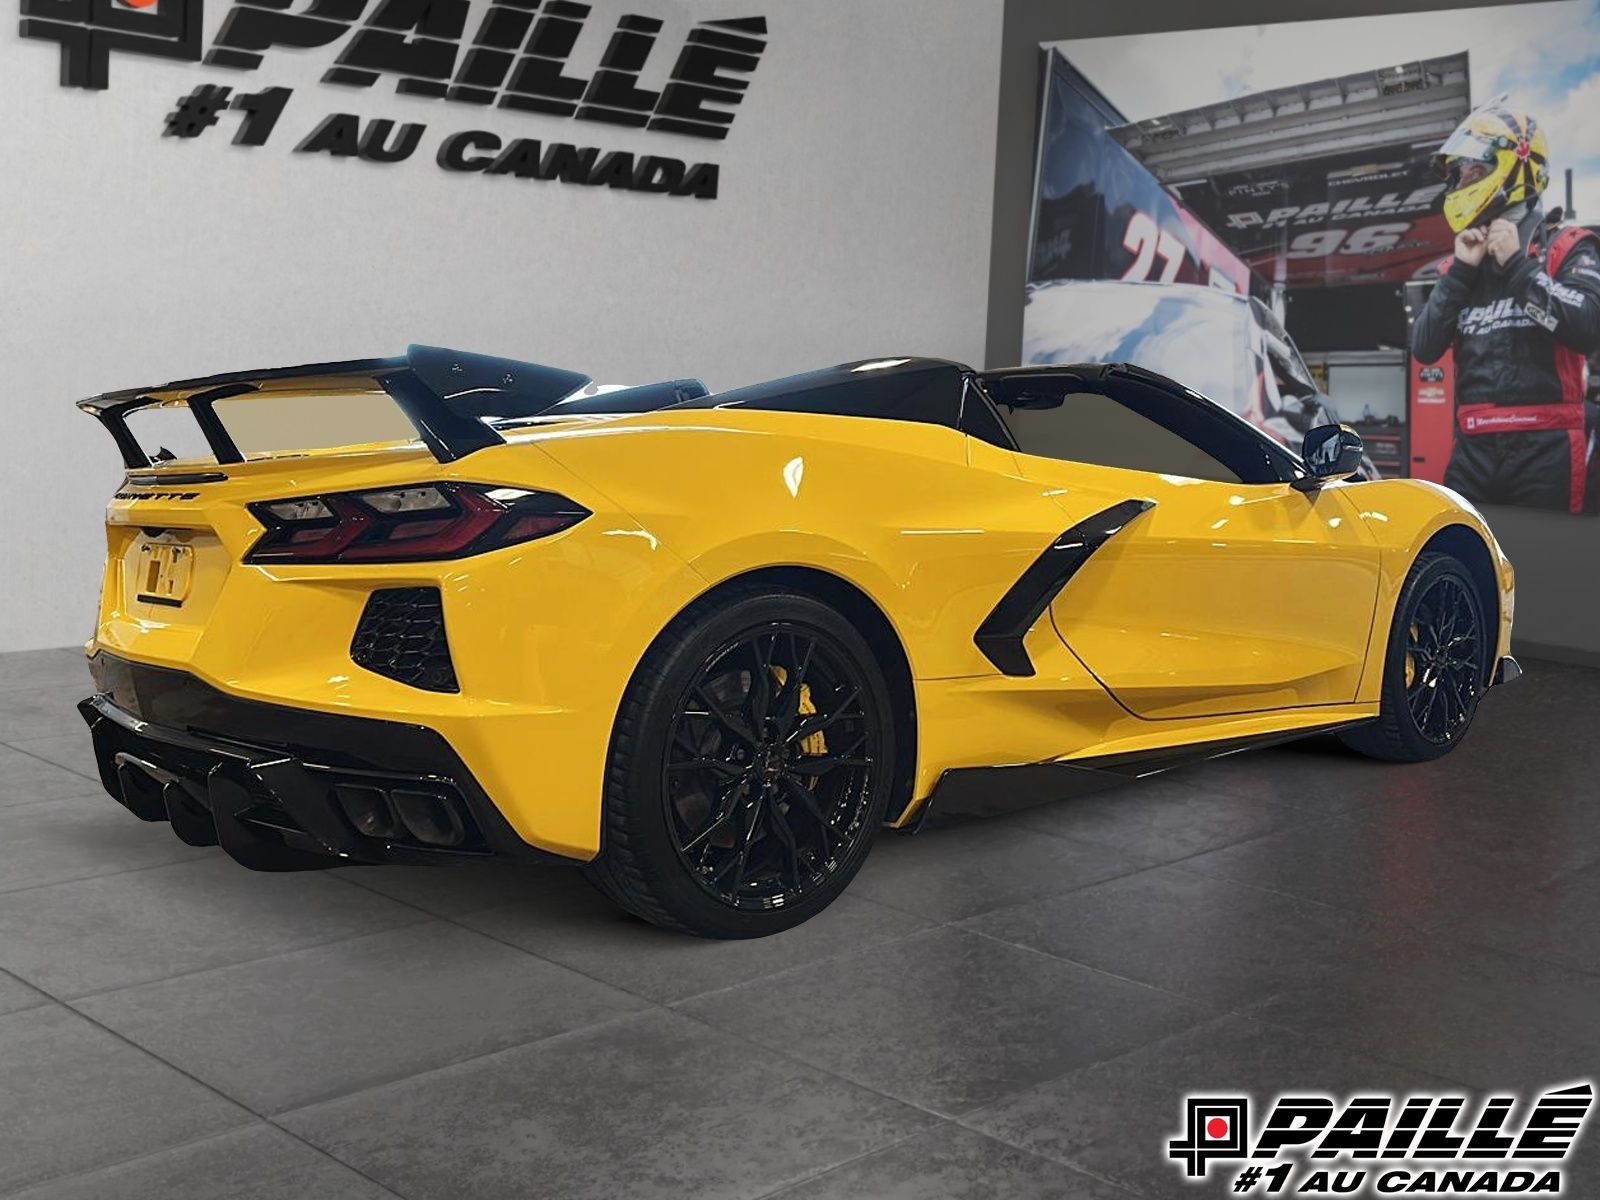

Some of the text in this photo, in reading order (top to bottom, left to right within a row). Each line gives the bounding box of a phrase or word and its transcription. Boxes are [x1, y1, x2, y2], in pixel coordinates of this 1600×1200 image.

[161, 83, 720, 200] #1 AU CANADA
[1120, 208, 1187, 284] 27
[1285, 222, 1412, 259] 96
